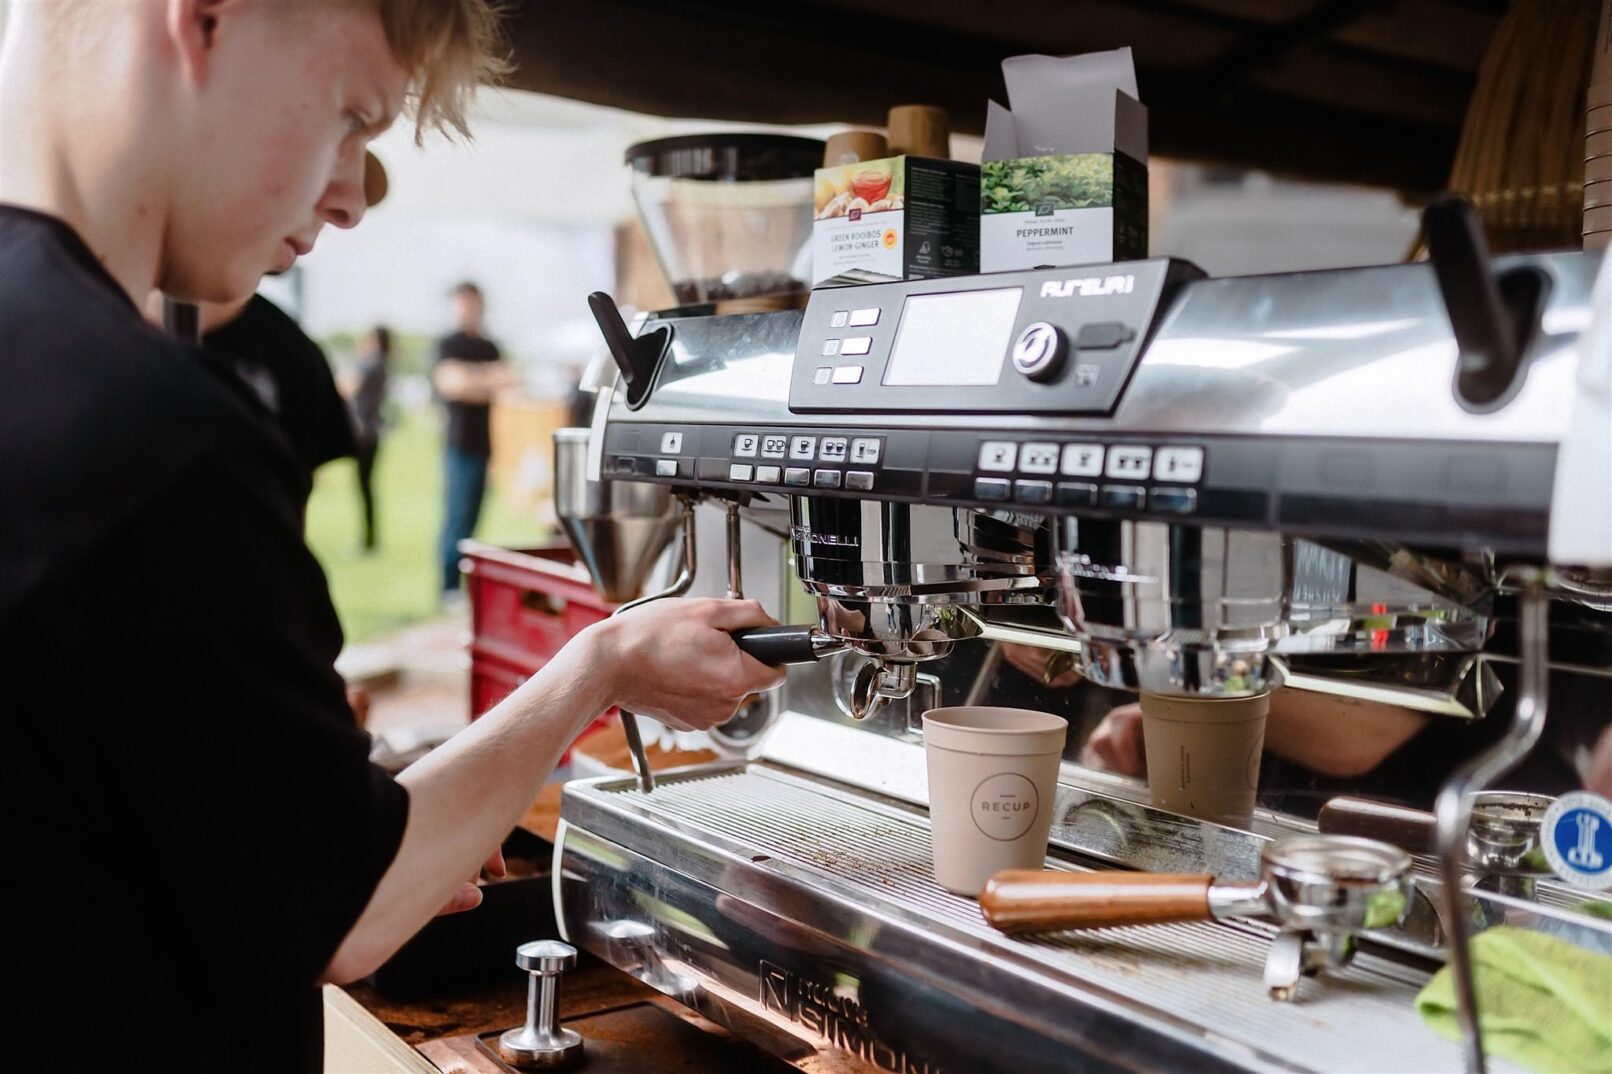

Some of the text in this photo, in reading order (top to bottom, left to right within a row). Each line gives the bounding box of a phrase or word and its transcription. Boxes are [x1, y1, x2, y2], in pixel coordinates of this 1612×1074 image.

[851, 229, 882, 241] ROOIBOS
[1016, 226, 1074, 238] PEPPERMINT
[981, 801, 1031, 812] RECUP
